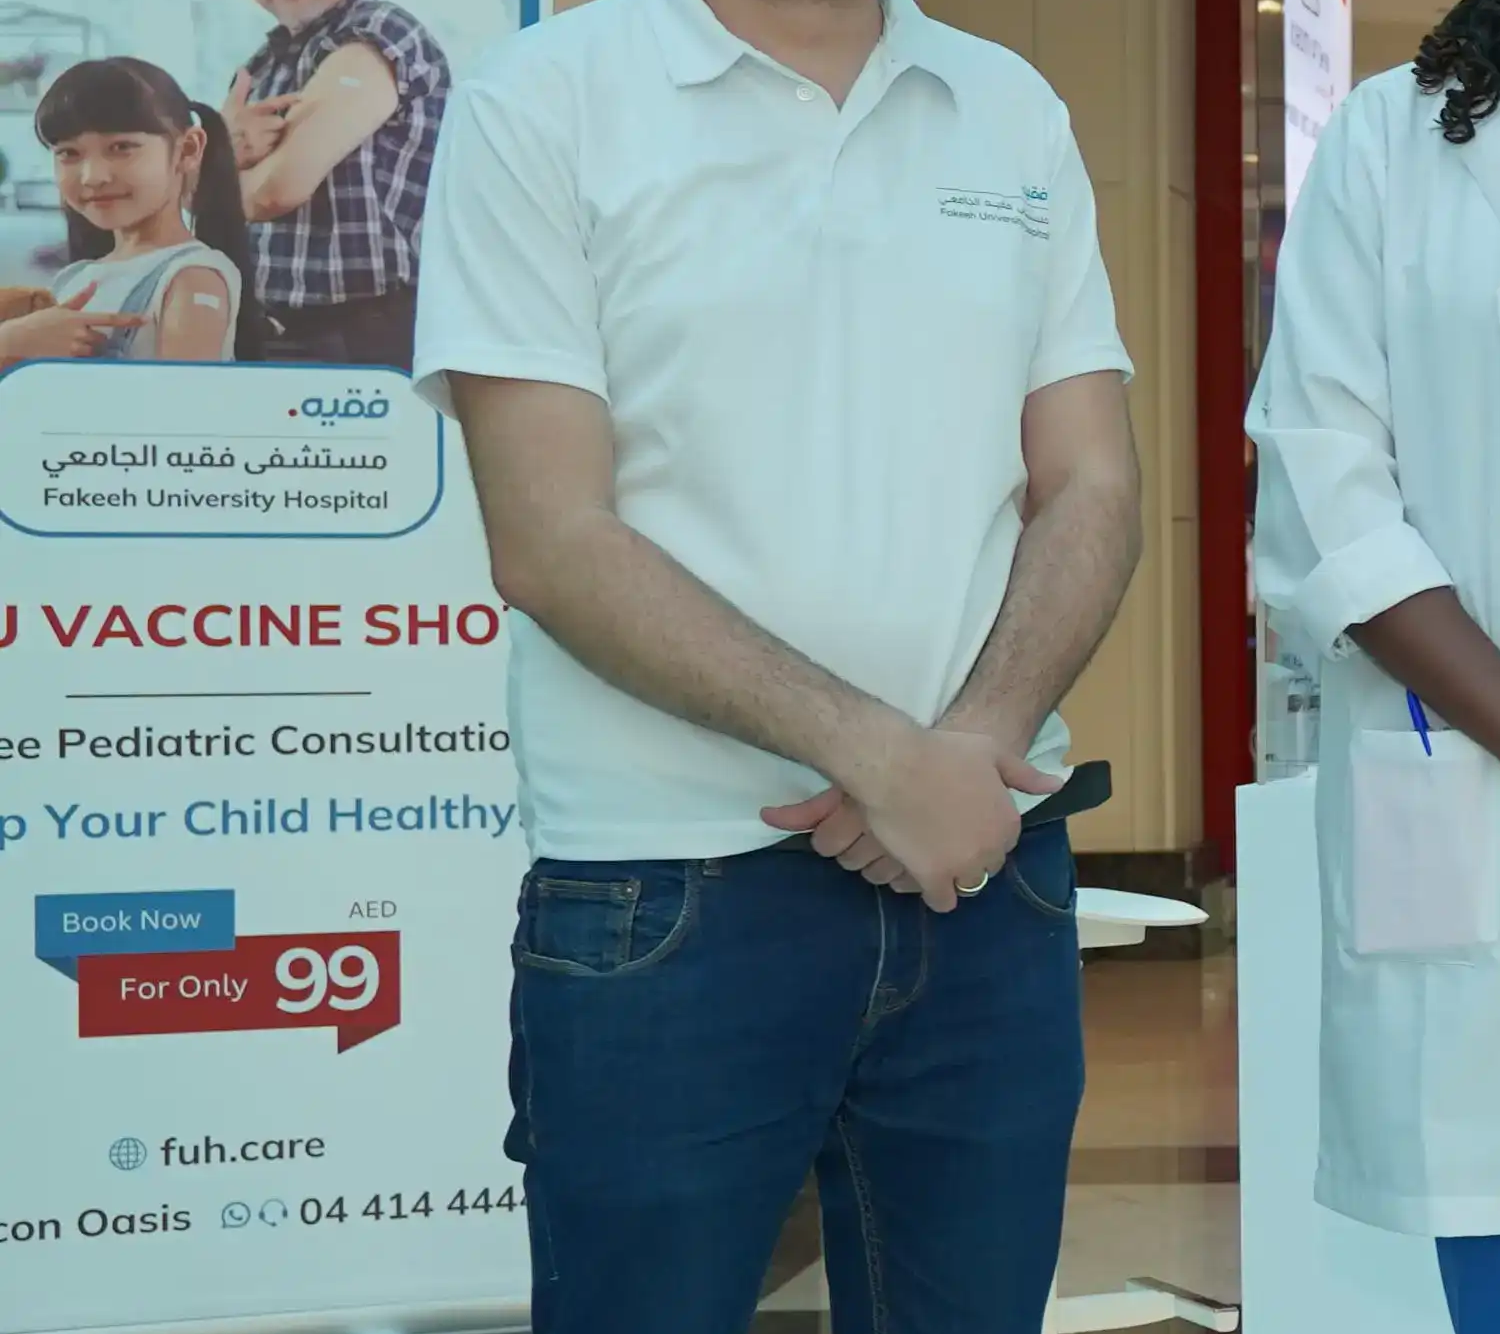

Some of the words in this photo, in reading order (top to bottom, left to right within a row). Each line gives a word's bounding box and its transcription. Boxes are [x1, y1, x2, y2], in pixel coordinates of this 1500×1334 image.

[42, 444, 158, 479] الجامعي
[166, 446, 236, 474] فقيه
[244, 443, 388, 475] مستشفى
[43, 487, 138, 509] Fakeeh
[146, 488, 276, 514] University
[283, 489, 389, 515] Hospital
[41, 604, 342, 648] VACCINE
[364, 603, 509, 647] SHO
[58, 724, 256, 759] Pediatric
[271, 721, 511, 756] Consultatio
[43, 803, 167, 840] Your
[184, 797, 309, 837] Child
[328, 793, 524, 839] Healthy
[62, 909, 132, 935] Book
[140, 909, 202, 931] Now
[348, 900, 398, 920] AED
[119, 977, 170, 1001] For
[178, 972, 249, 1003] Only
[274, 944, 380, 1015] 99
[160, 1135, 326, 1166] fuh.care
[77, 1204, 192, 1238] Oasis
[300, 1195, 349, 1226] 04
[361, 1190, 434, 1222] 414
